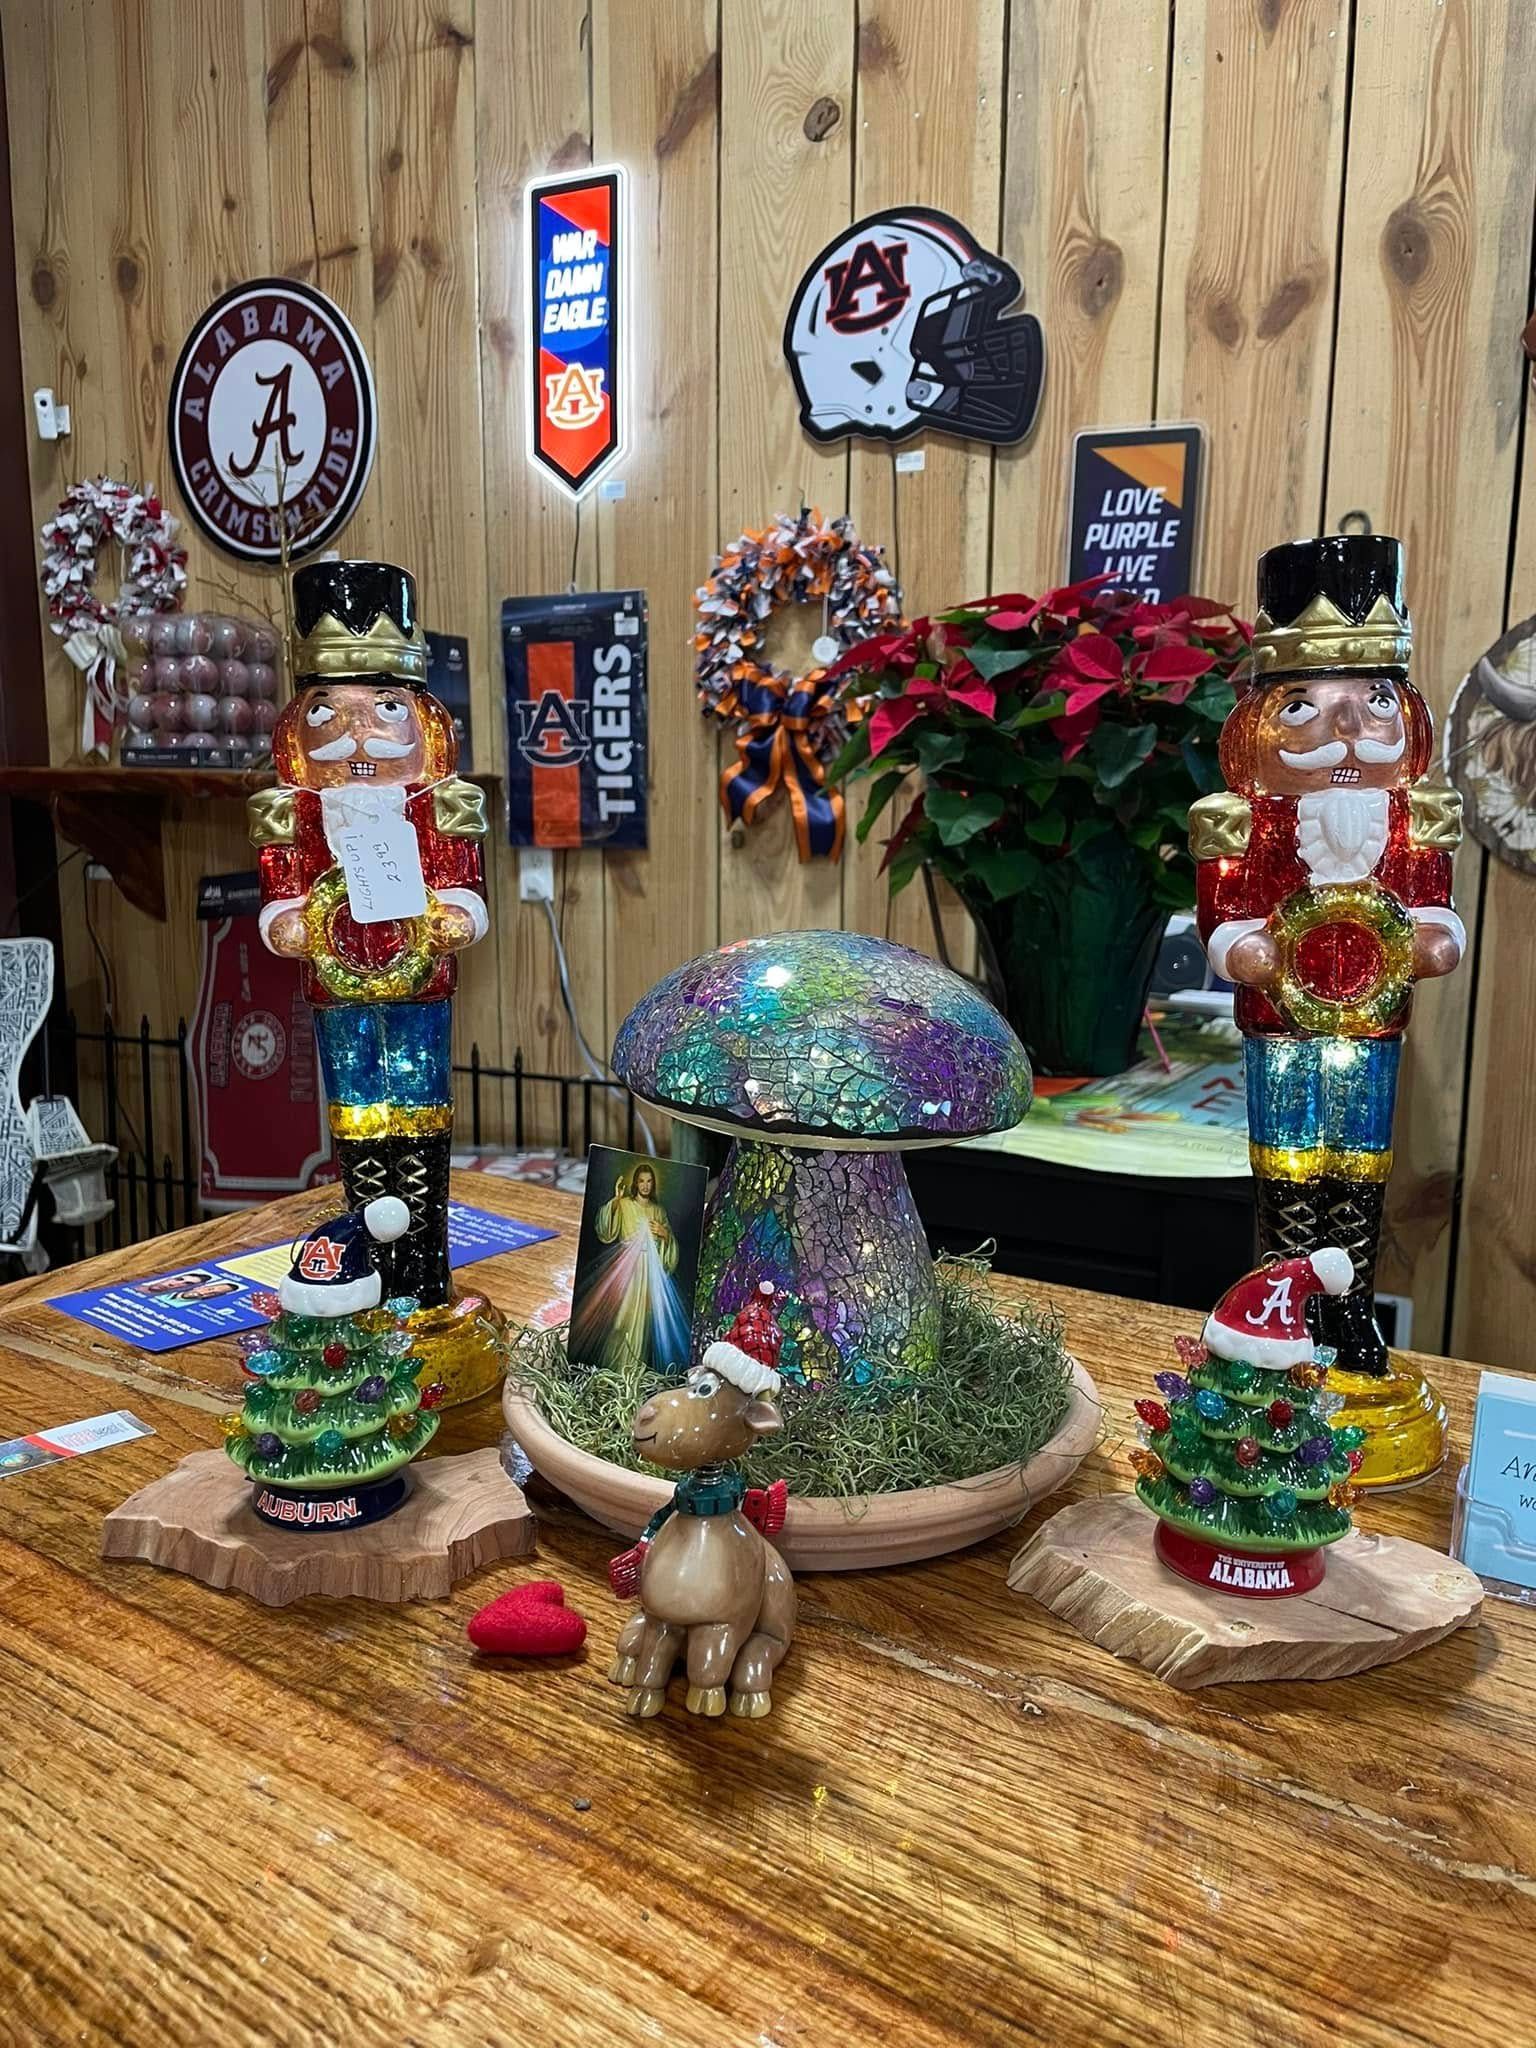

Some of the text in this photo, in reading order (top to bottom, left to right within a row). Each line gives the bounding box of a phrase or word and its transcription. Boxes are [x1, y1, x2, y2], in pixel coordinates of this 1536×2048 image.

[552, 229, 598, 264] WAR
[545, 262, 604, 300] DAMN
[185, 303, 345, 422] ALABAMA
[229, 363, 304, 477] A
[190, 427, 355, 544] CRIMSON TIDE
[1101, 486, 1167, 517] LOVE
[1083, 520, 1180, 551] PURPLE
[1103, 554, 1158, 583] LIVE
[592, 643, 646, 822] TIGERS
[353, 866, 374, 911] LIGHTS
[1245, 1276, 1294, 1325] A
